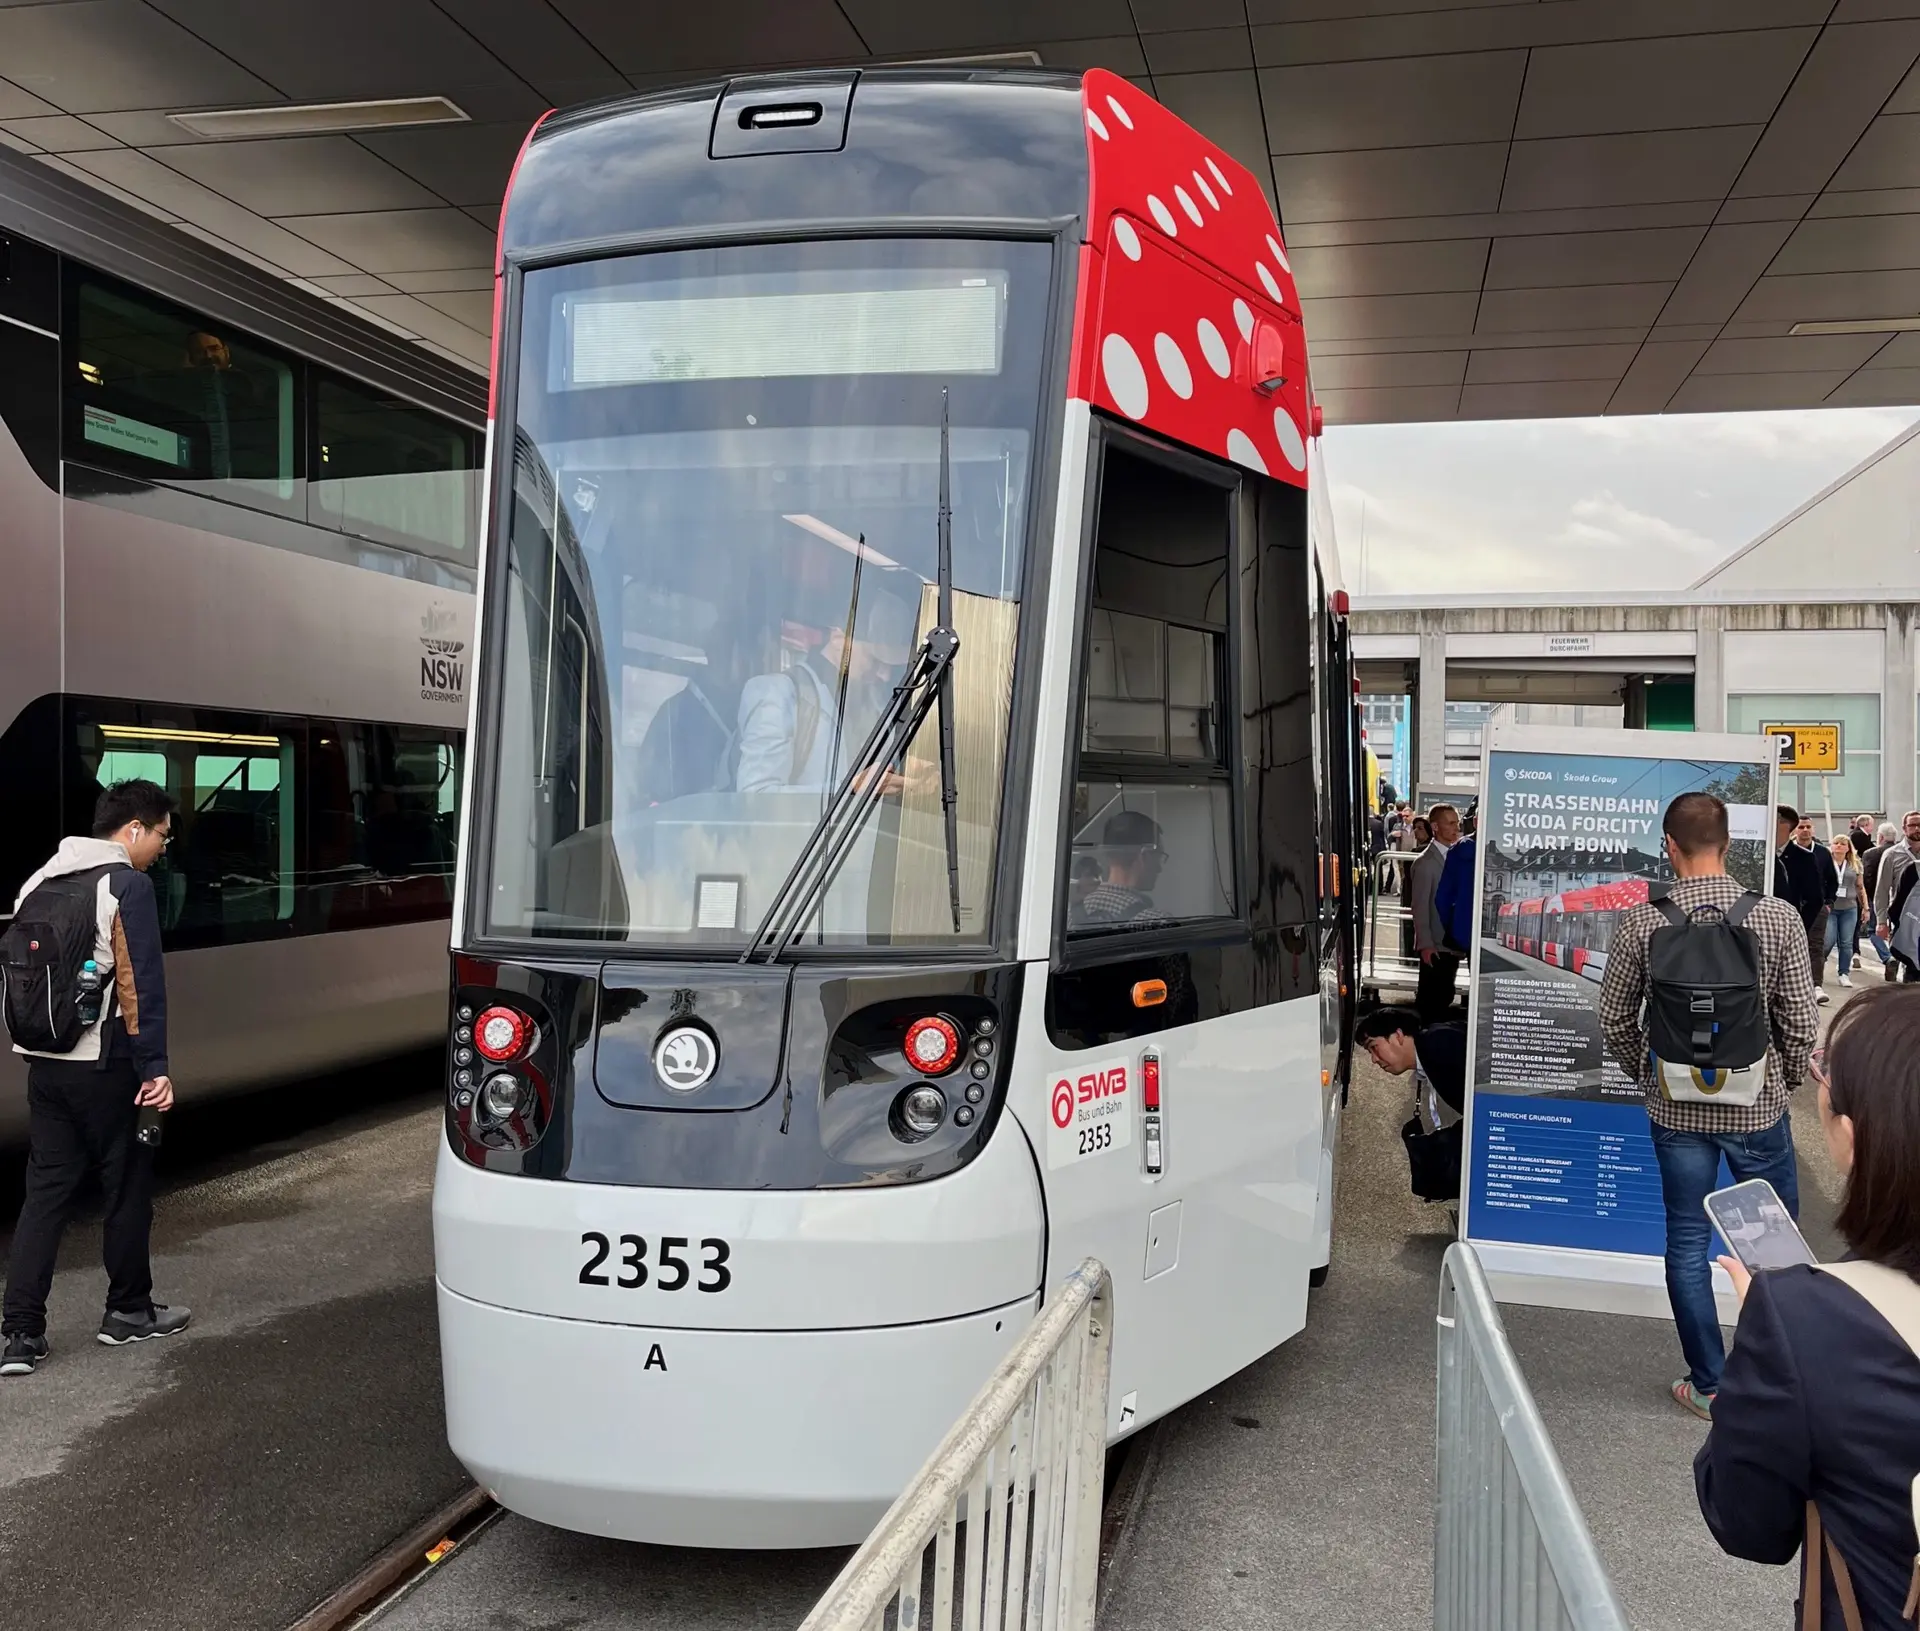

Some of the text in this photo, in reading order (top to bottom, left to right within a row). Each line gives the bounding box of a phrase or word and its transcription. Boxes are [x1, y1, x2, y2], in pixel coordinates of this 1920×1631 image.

[421, 657, 464, 691] NSW
[421, 690, 463, 703] GOVERNMENT
[1518, 769, 1552, 780] ŠKODA
[1564, 772, 1618, 784] Škoda Group
[1504, 792, 1659, 815] STRASSENBAHN
[1503, 809, 1653, 834] ŠKODA FORCITY
[1502, 833, 1628, 854] SMART BONN
[1495, 978, 1551, 988] PREISGEKRÖNTES
[1493, 1008, 1540, 1017] VOLLSTÄNDIGE
[1493, 1016, 1555, 1025] BARRIEREFREIHEIT
[1492, 1053, 1575, 1064] ERSTKLASSIGER KOMFORT
[1078, 1067, 1126, 1104] SWB
[1078, 1100, 1122, 1122] Bus und Bahn
[1488, 1111, 1572, 1124] TECHNISCHE GRUNDDATEN
[1078, 1123, 1112, 1155] 2353
[578, 1231, 732, 1293] 2353
[643, 1344, 668, 1372] A
